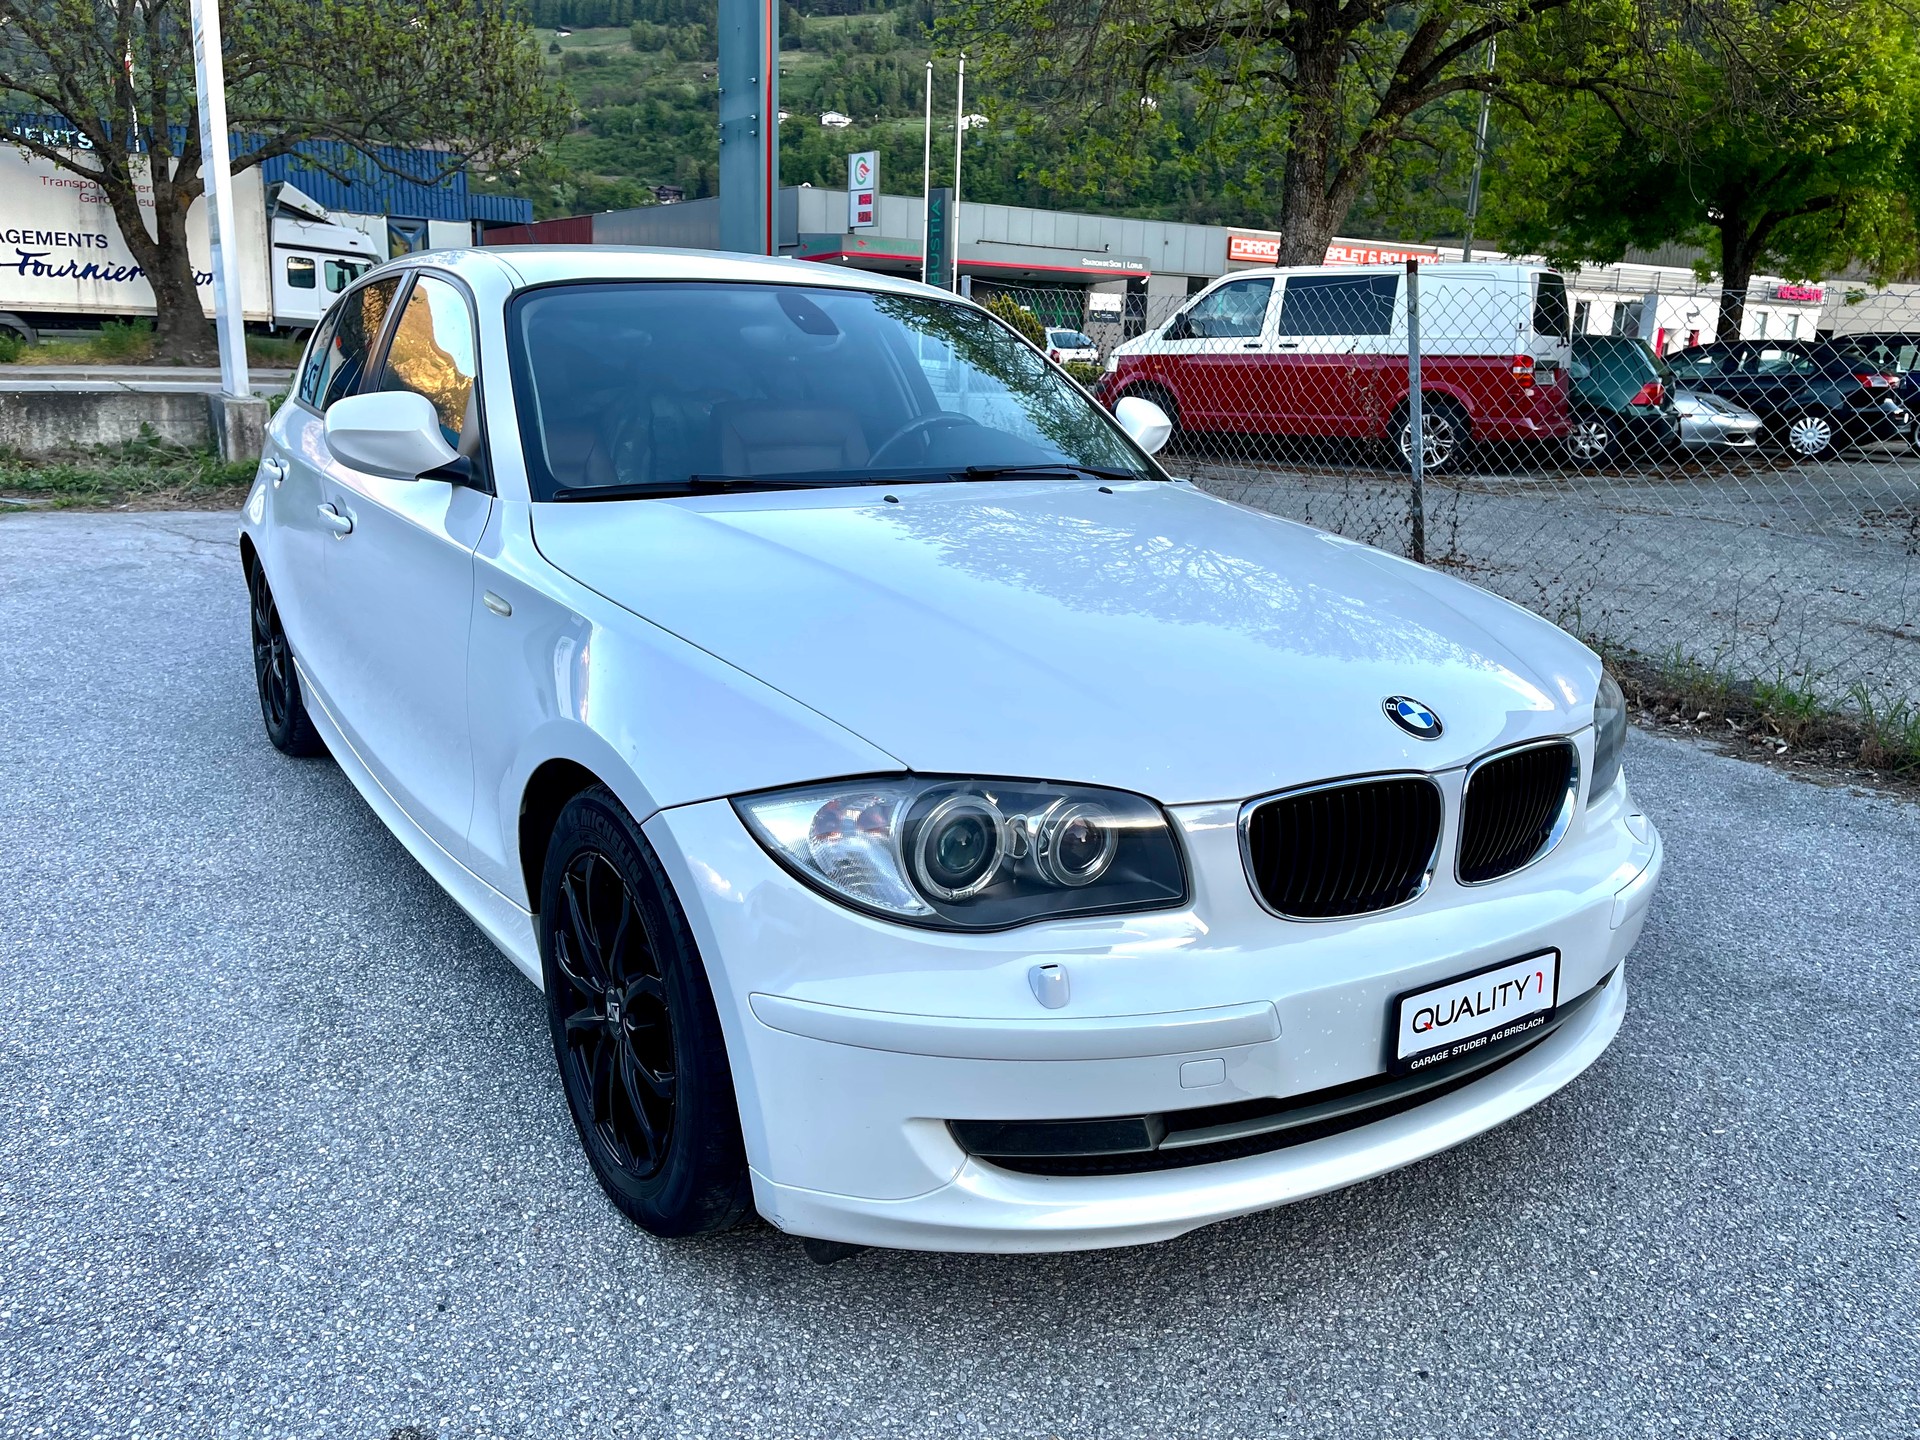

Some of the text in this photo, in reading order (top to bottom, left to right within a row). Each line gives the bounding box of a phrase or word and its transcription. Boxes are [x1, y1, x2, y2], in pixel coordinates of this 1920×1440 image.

[580, 807, 643, 885] MICHELIN
[1411, 1016, 1545, 1070] GARAGE STUDER AG BRISLACH
